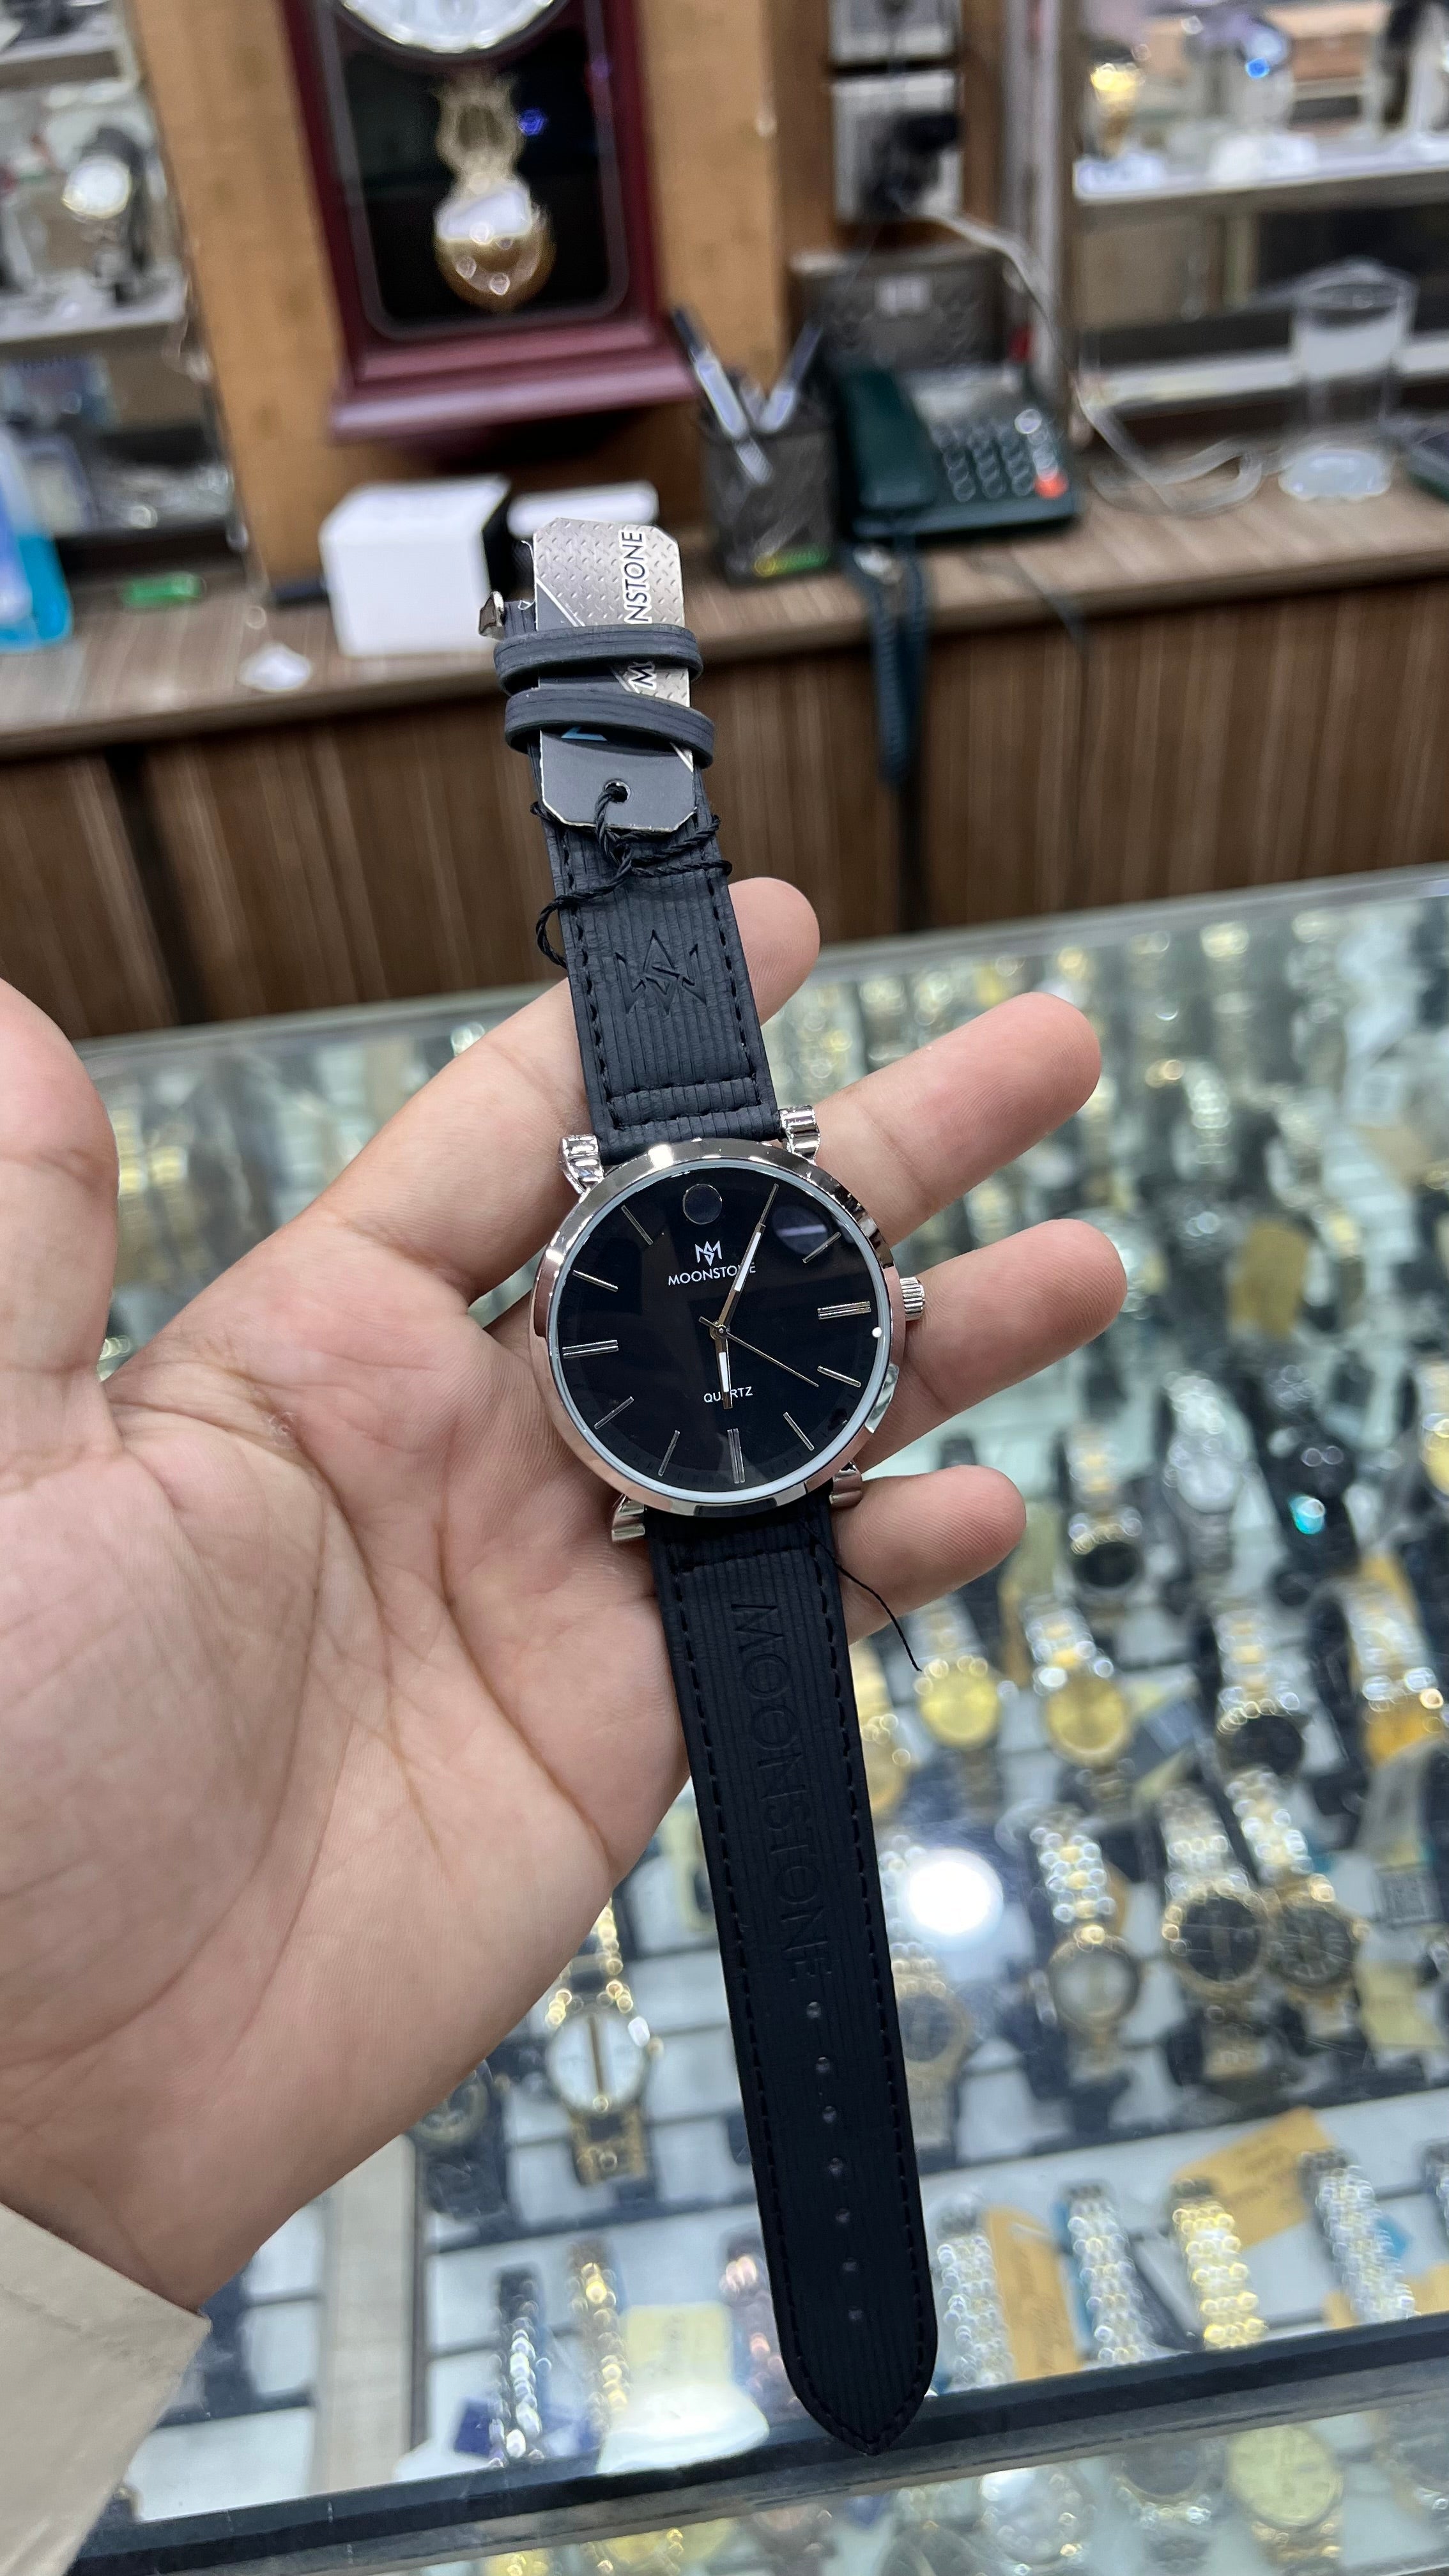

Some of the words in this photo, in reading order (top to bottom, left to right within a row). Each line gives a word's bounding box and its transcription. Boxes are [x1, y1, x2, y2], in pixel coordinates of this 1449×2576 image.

[621, 531, 655, 687] MNSTONE
[668, 1262, 756, 1286] MOONSTOE
[703, 1386, 753, 1403] QURTZ
[730, 1603, 832, 1982] MOONSTONE
